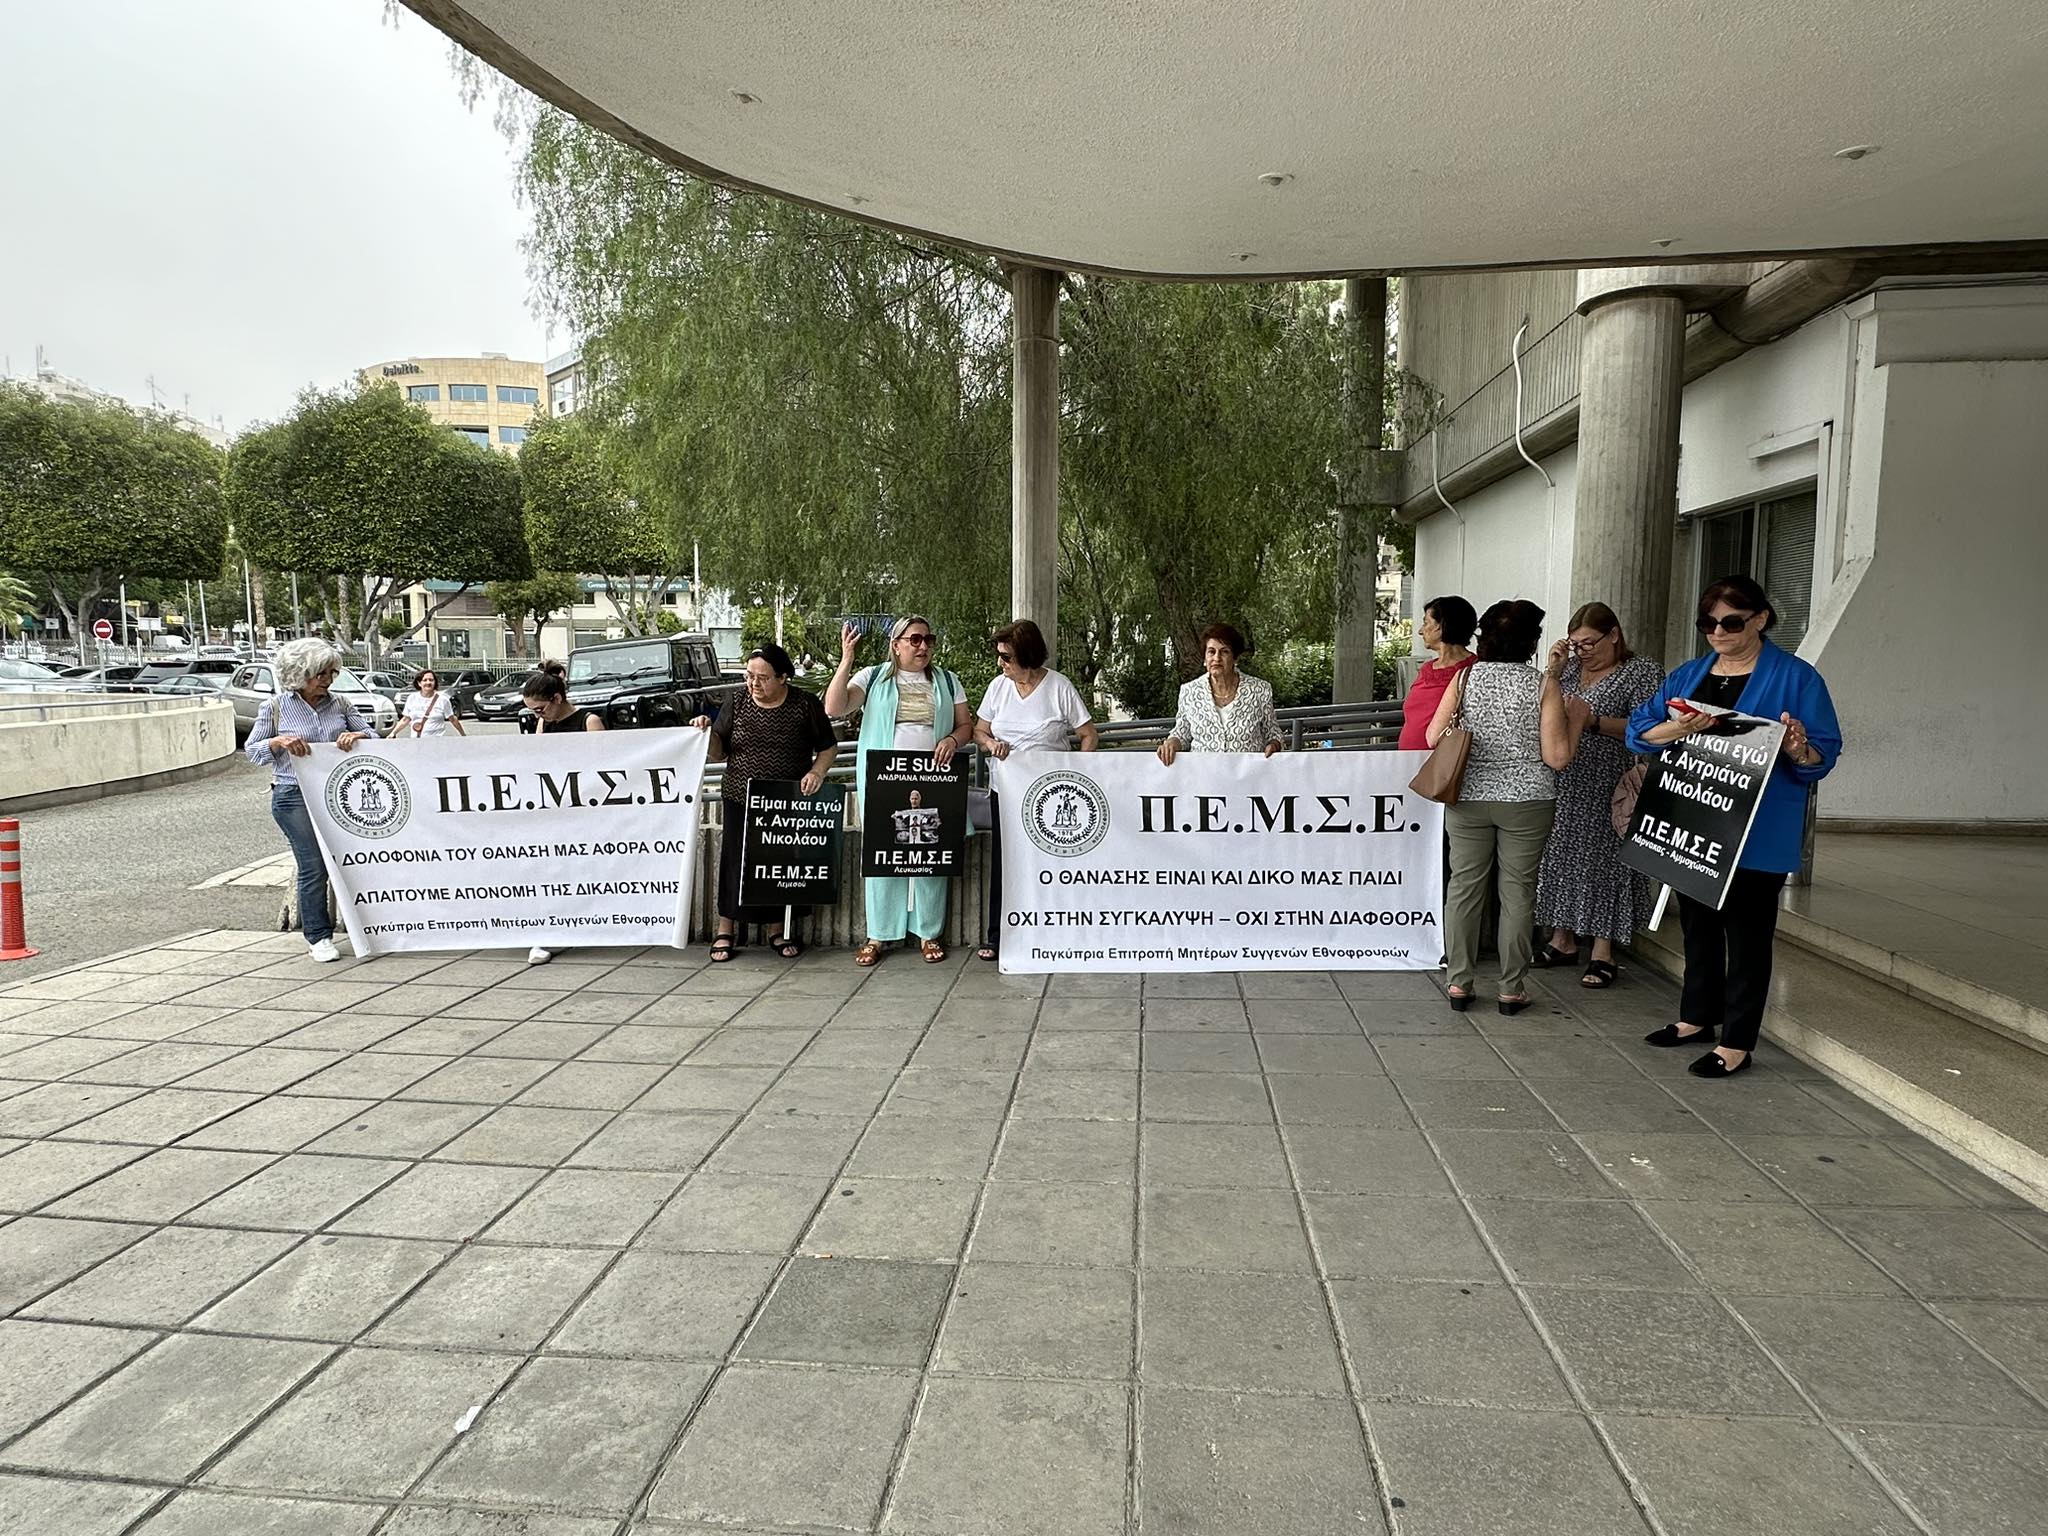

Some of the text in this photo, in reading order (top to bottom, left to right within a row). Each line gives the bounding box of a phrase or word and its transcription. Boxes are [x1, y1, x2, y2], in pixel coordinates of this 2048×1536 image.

[1703, 736, 1730, 755] και
[1732, 744, 1768, 766] εγώ
[886, 757, 907, 771] JE
[1659, 749, 1751, 790] κ. Αντριάνα
[877, 773, 959, 783] ΑΝΔΡΙΑΝΑ ΝΙΚΟΛΑΟΥ
[433, 767, 694, 813] Π.Ε.Μ.Σ.Ε.
[1658, 771, 1734, 812] Νικολάου
[750, 795, 842, 815] Είμαι και εγώ
[1137, 794, 1422, 835] Π.Ε.Μ.Σ.Ε.
[755, 814, 834, 831] κ. Αντριάνα
[761, 831, 827, 845] Νικολάου
[1639, 813, 1723, 865] Π.Ε.Μ.Σ.Ε
[342, 850, 442, 866] ΔΟΛΟΦΟΝΙΑ
[445, 848, 477, 861] ΤΟΥ
[482, 845, 550, 860] ΘΑΝΑΣΗ
[554, 843, 589, 857] ΜΑΣ
[592, 841, 650, 856] ΑΦΟΡΑ
[653, 840, 686, 854] ΟΛΟ
[874, 850, 953, 865] Π.Ε.Μ.Σ.Ε
[755, 865, 828, 879] Π.Ε.Μ.Σ.Ε
[1039, 870, 1402, 885] Ο ΘΑΝΑΣΗΣ ΕΙΝΑΙ ΚΑΙ ΔΙΚΟ ΜΑΣ ΠΑΙΔΙ
[354, 881, 680, 906] ΑΠΑΙΤΟΥΜΕ ΑΠΟΝΟΜΗ ΤΗΣ ΔΙΚΑΙΟΣΥΝΗΣ
[363, 913, 675, 935] αγκύπρια Επιτροπή Μητέρων Συγγενών Εθνοφρου
[1007, 911, 1038, 926] ΟΧΙ
[1044, 911, 1093, 926] ΣΤΗΝ
[1099, 911, 1214, 926] ΣΥΓΚΑΛΥΨΗ
[1236, 911, 1268, 926] ΟΧΙ
[1274, 911, 1324, 926] ΣΤΗΝ
[1329, 911, 1436, 927] ΔΙΑΦΘΟΡΑ
[1032, 947, 1409, 962] Παγκύπρια Επιτροπή Μητέρων Συγγενών Εθνοφρουρών
